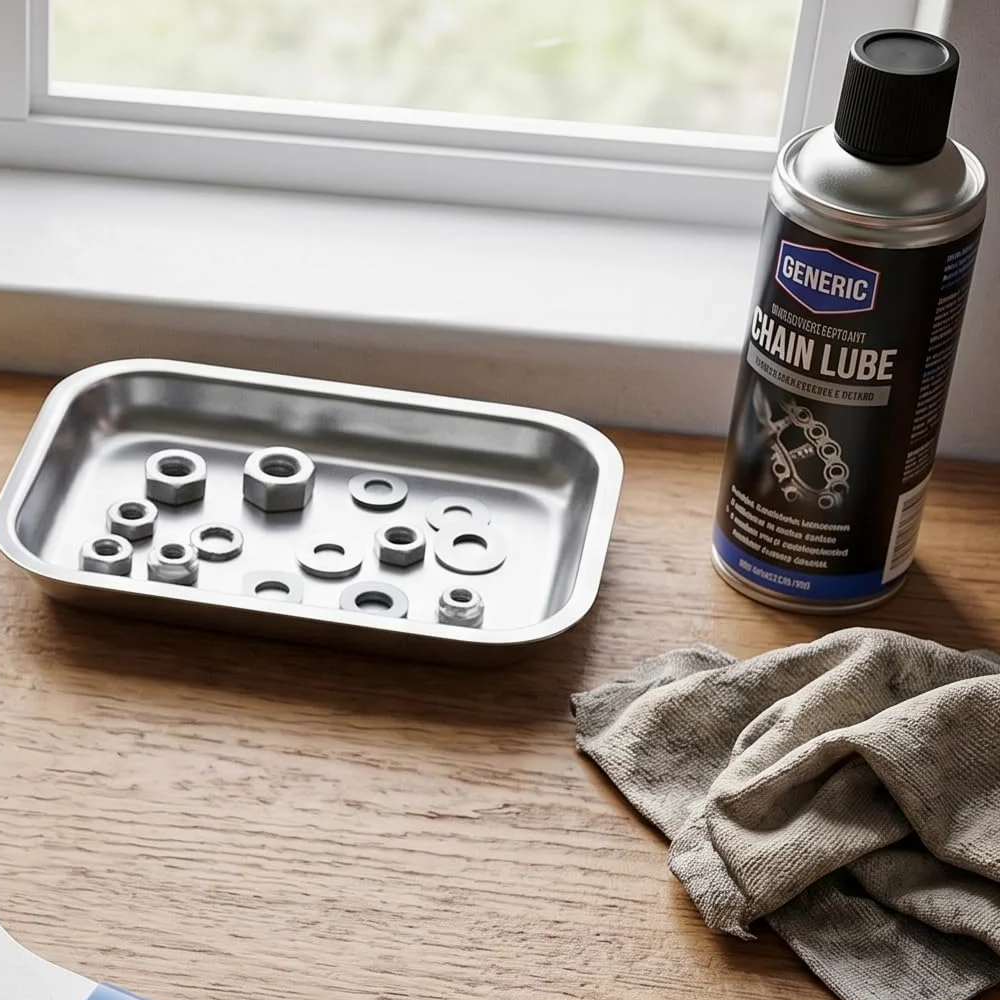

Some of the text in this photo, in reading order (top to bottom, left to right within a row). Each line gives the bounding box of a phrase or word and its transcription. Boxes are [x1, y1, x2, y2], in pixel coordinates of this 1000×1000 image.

[782, 254, 869, 301] GENERIC
[751, 304, 815, 371] CHAIN
[820, 343, 898, 381] LUBE
